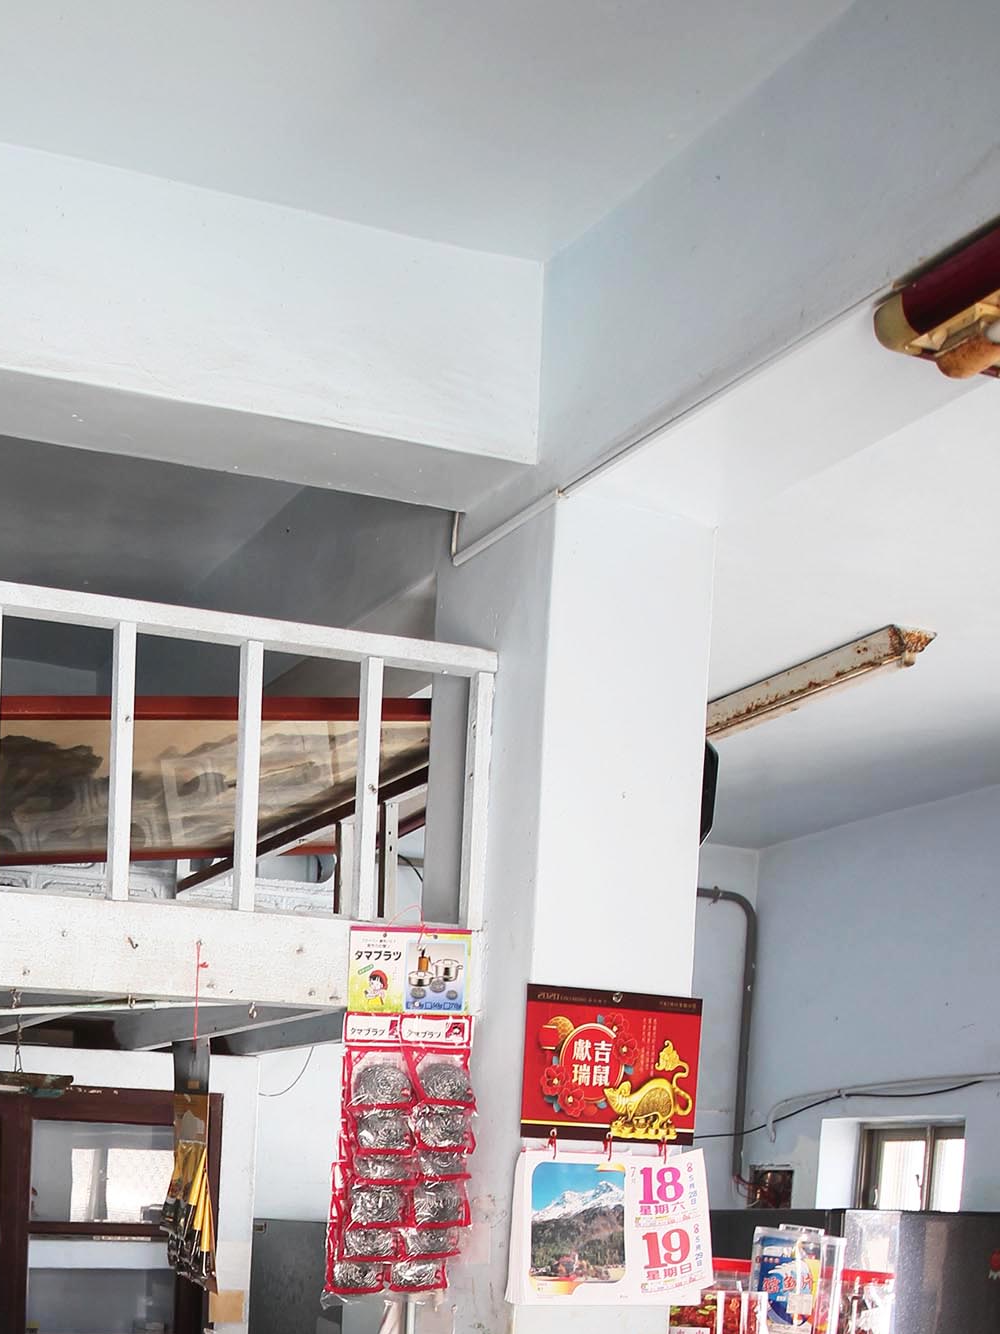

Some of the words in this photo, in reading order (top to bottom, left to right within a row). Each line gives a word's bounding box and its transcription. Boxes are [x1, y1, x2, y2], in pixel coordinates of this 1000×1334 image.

[638, 1167, 684, 1205] 18
[640, 1202, 685, 1216] 星期六
[642, 1228, 691, 1270] 19
[646, 1262, 692, 1280] 星期日
